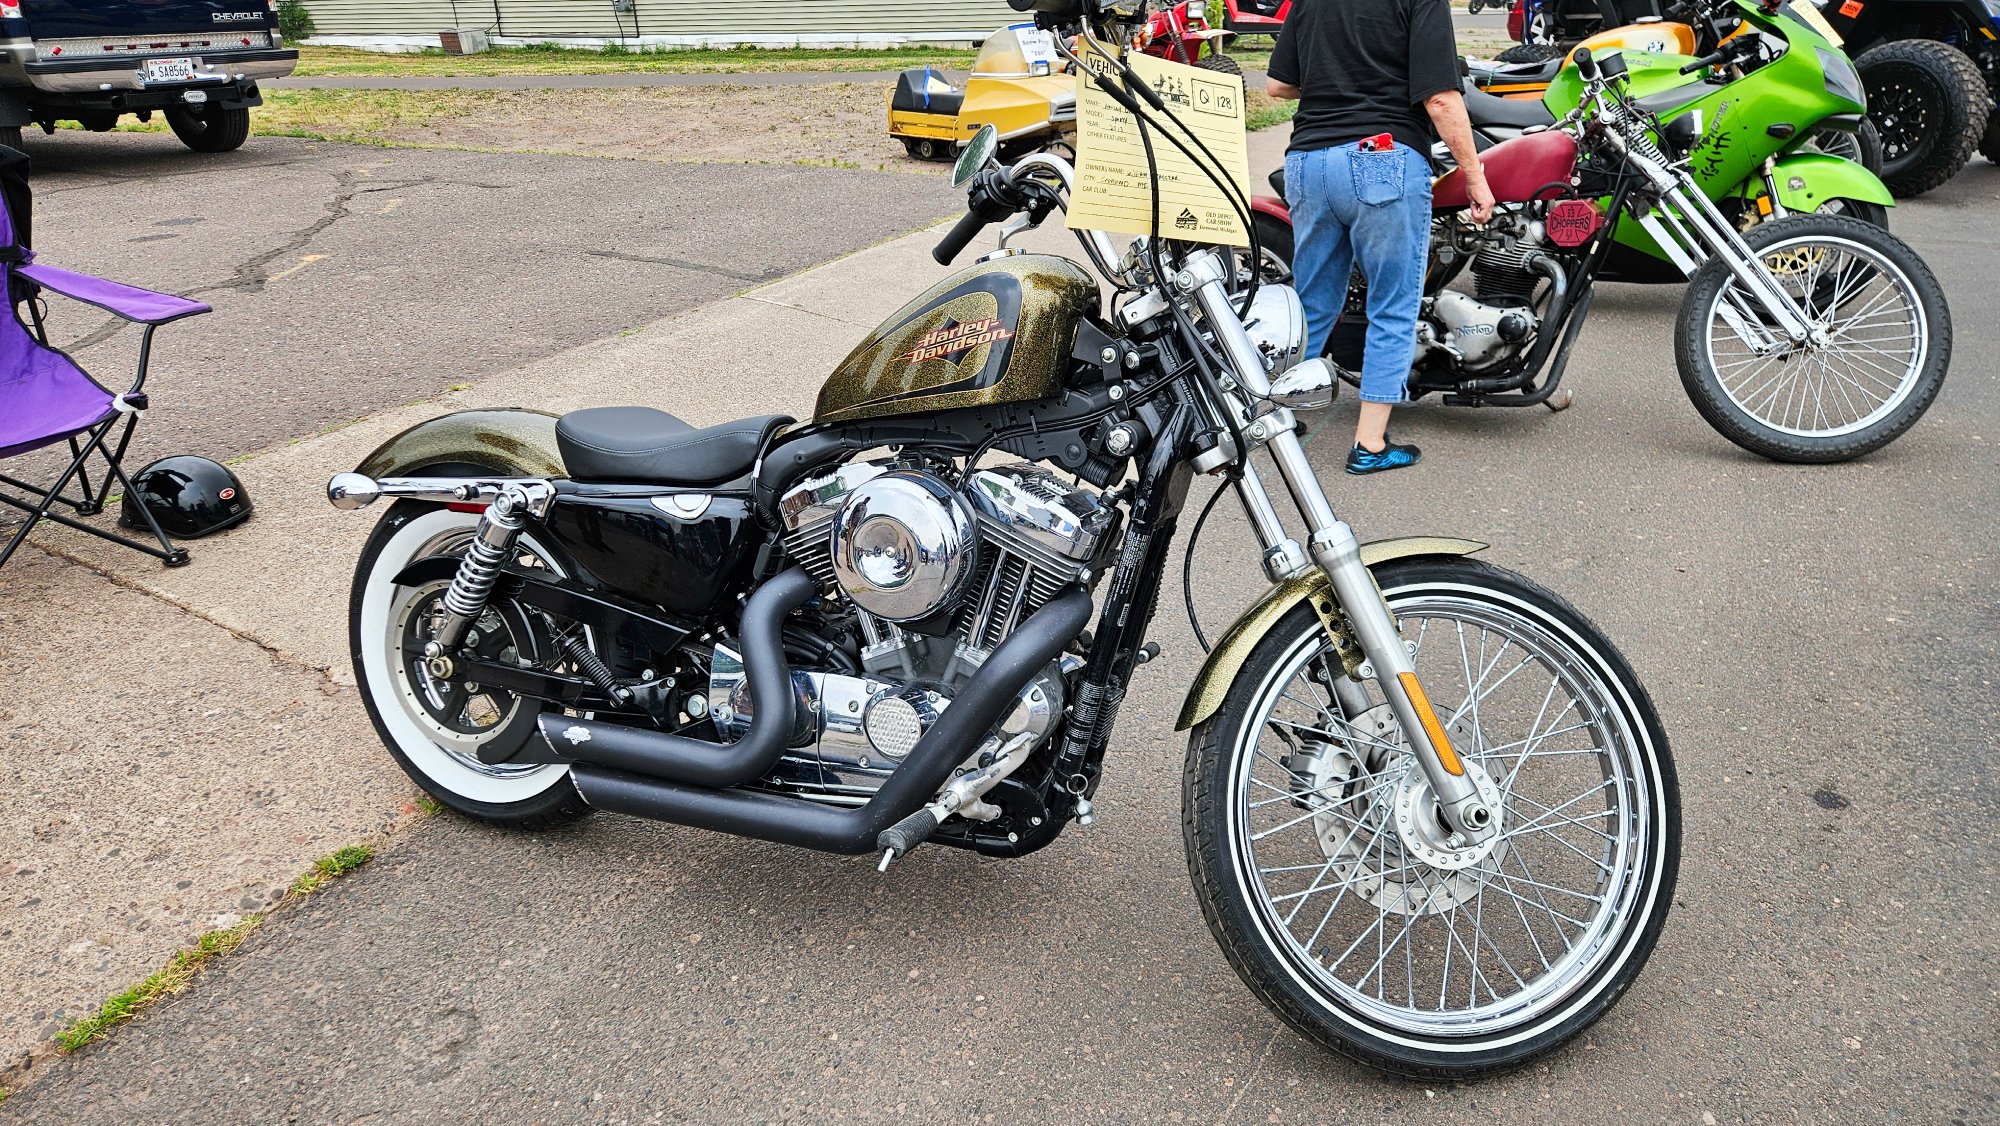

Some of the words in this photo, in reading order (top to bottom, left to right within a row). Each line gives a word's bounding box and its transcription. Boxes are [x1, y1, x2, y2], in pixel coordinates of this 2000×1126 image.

[212, 12, 264, 21] CHEVROLET
[158, 65, 190, 78] SA8566
[1085, 98, 1101, 107] MAKE:
[1216, 96, 1232, 110] 128
[1085, 109, 1105, 118] MODEL:
[1086, 130, 1103, 139] OTHER
[1085, 163, 1108, 173] OWNERS
[1108, 166, 1125, 175] NAME:
[1082, 185, 1093, 193] CAR
[1217, 212, 1234, 221] DEPOT
[1217, 219, 1232, 227] SHOW
[1551, 215, 1590, 231] CHOPPERS
[1455, 323, 1494, 339] Norton
[906, 328, 1013, 365] Davidson
